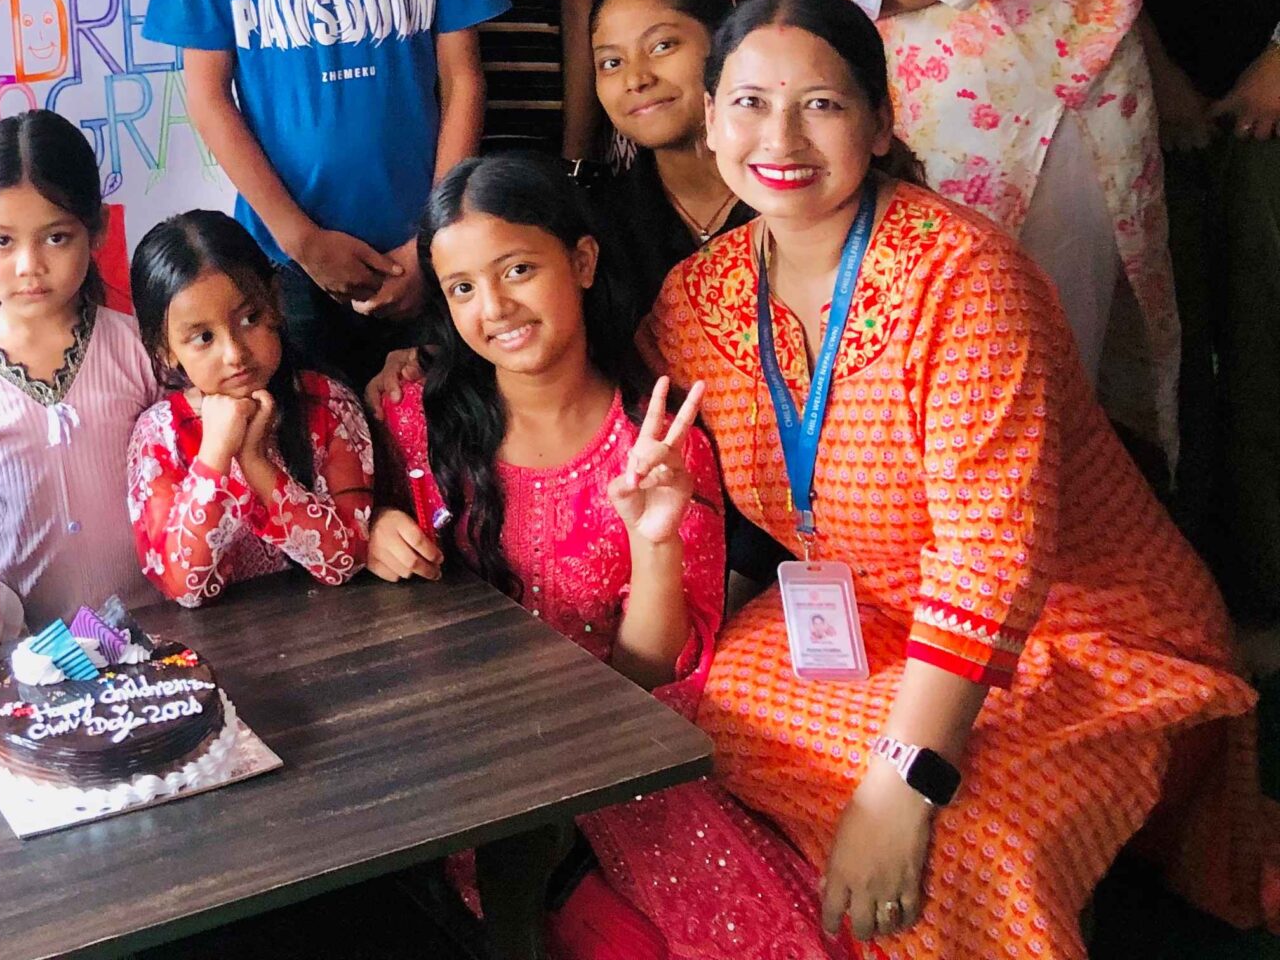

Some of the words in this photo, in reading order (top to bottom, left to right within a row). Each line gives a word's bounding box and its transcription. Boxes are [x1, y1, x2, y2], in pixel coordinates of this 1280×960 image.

[839, 269, 854, 295] CHILD
[819, 350, 832, 376] NEPAL
[810, 375, 827, 411] WELFARE
[806, 411, 818, 436] CHILD
